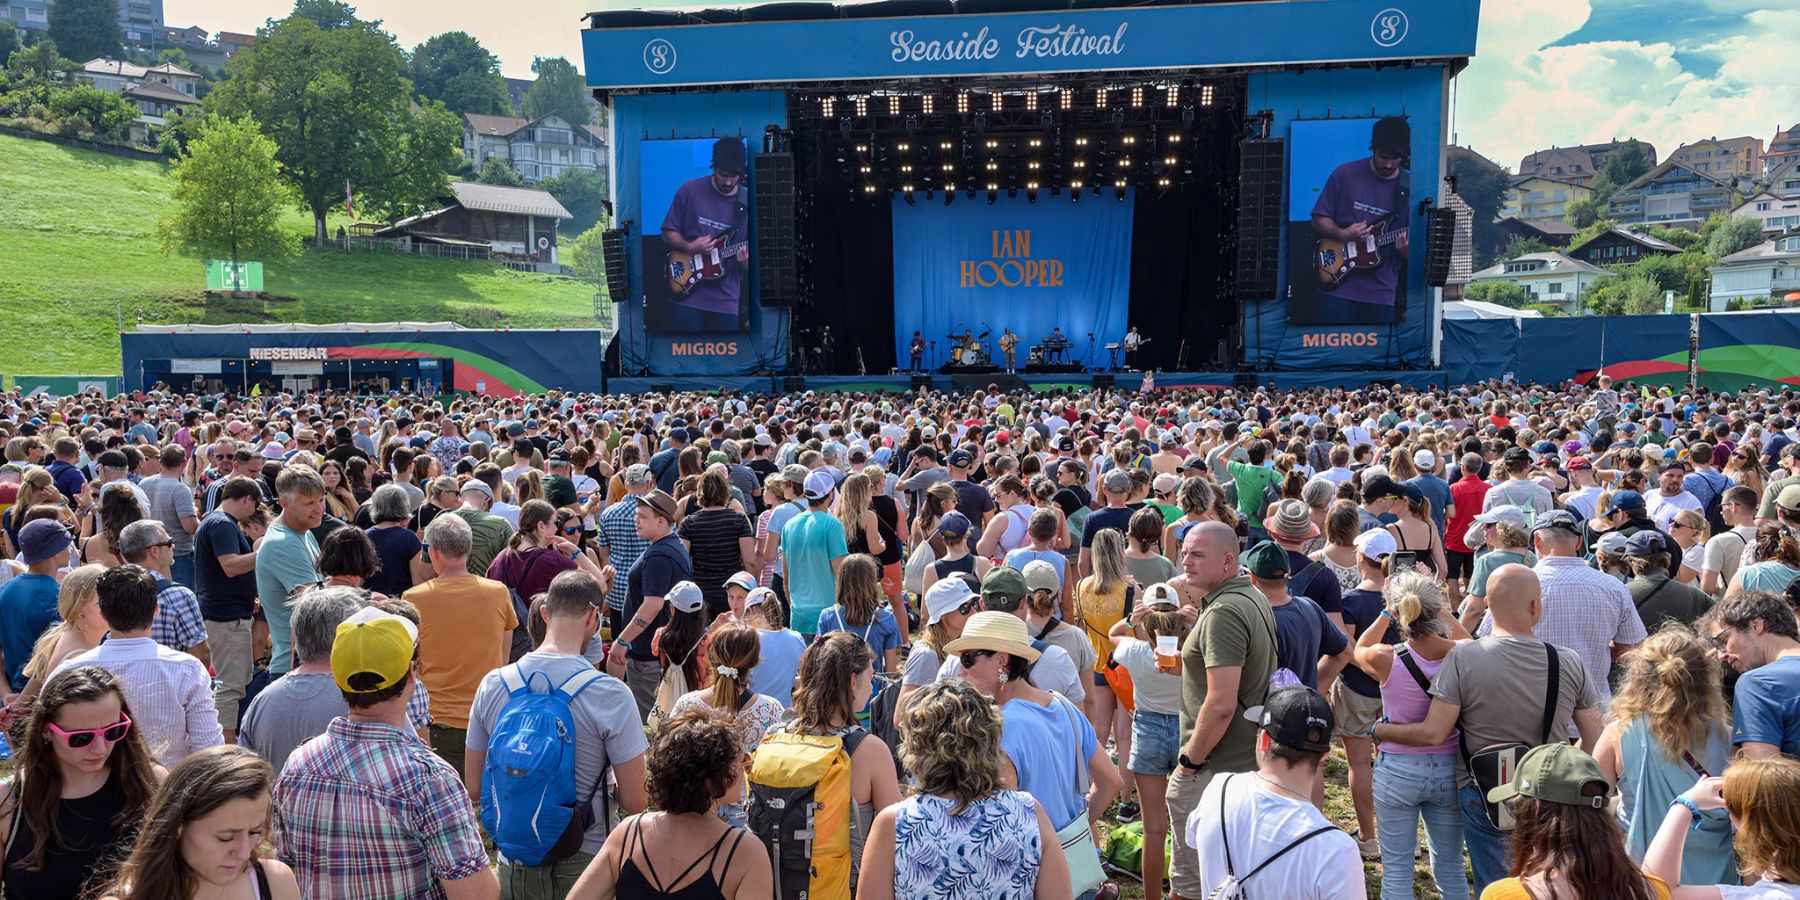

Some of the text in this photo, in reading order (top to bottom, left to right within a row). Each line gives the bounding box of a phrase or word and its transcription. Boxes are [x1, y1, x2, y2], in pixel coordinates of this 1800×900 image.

[890, 22, 1129, 63] Seaside Festival
[992, 230, 1031, 258] IAN
[960, 260, 1063, 287] HOOPER
[672, 342, 737, 356] MIGROS
[1303, 332, 1378, 347] MIGROS
[249, 347, 328, 360] NIESENBAR
